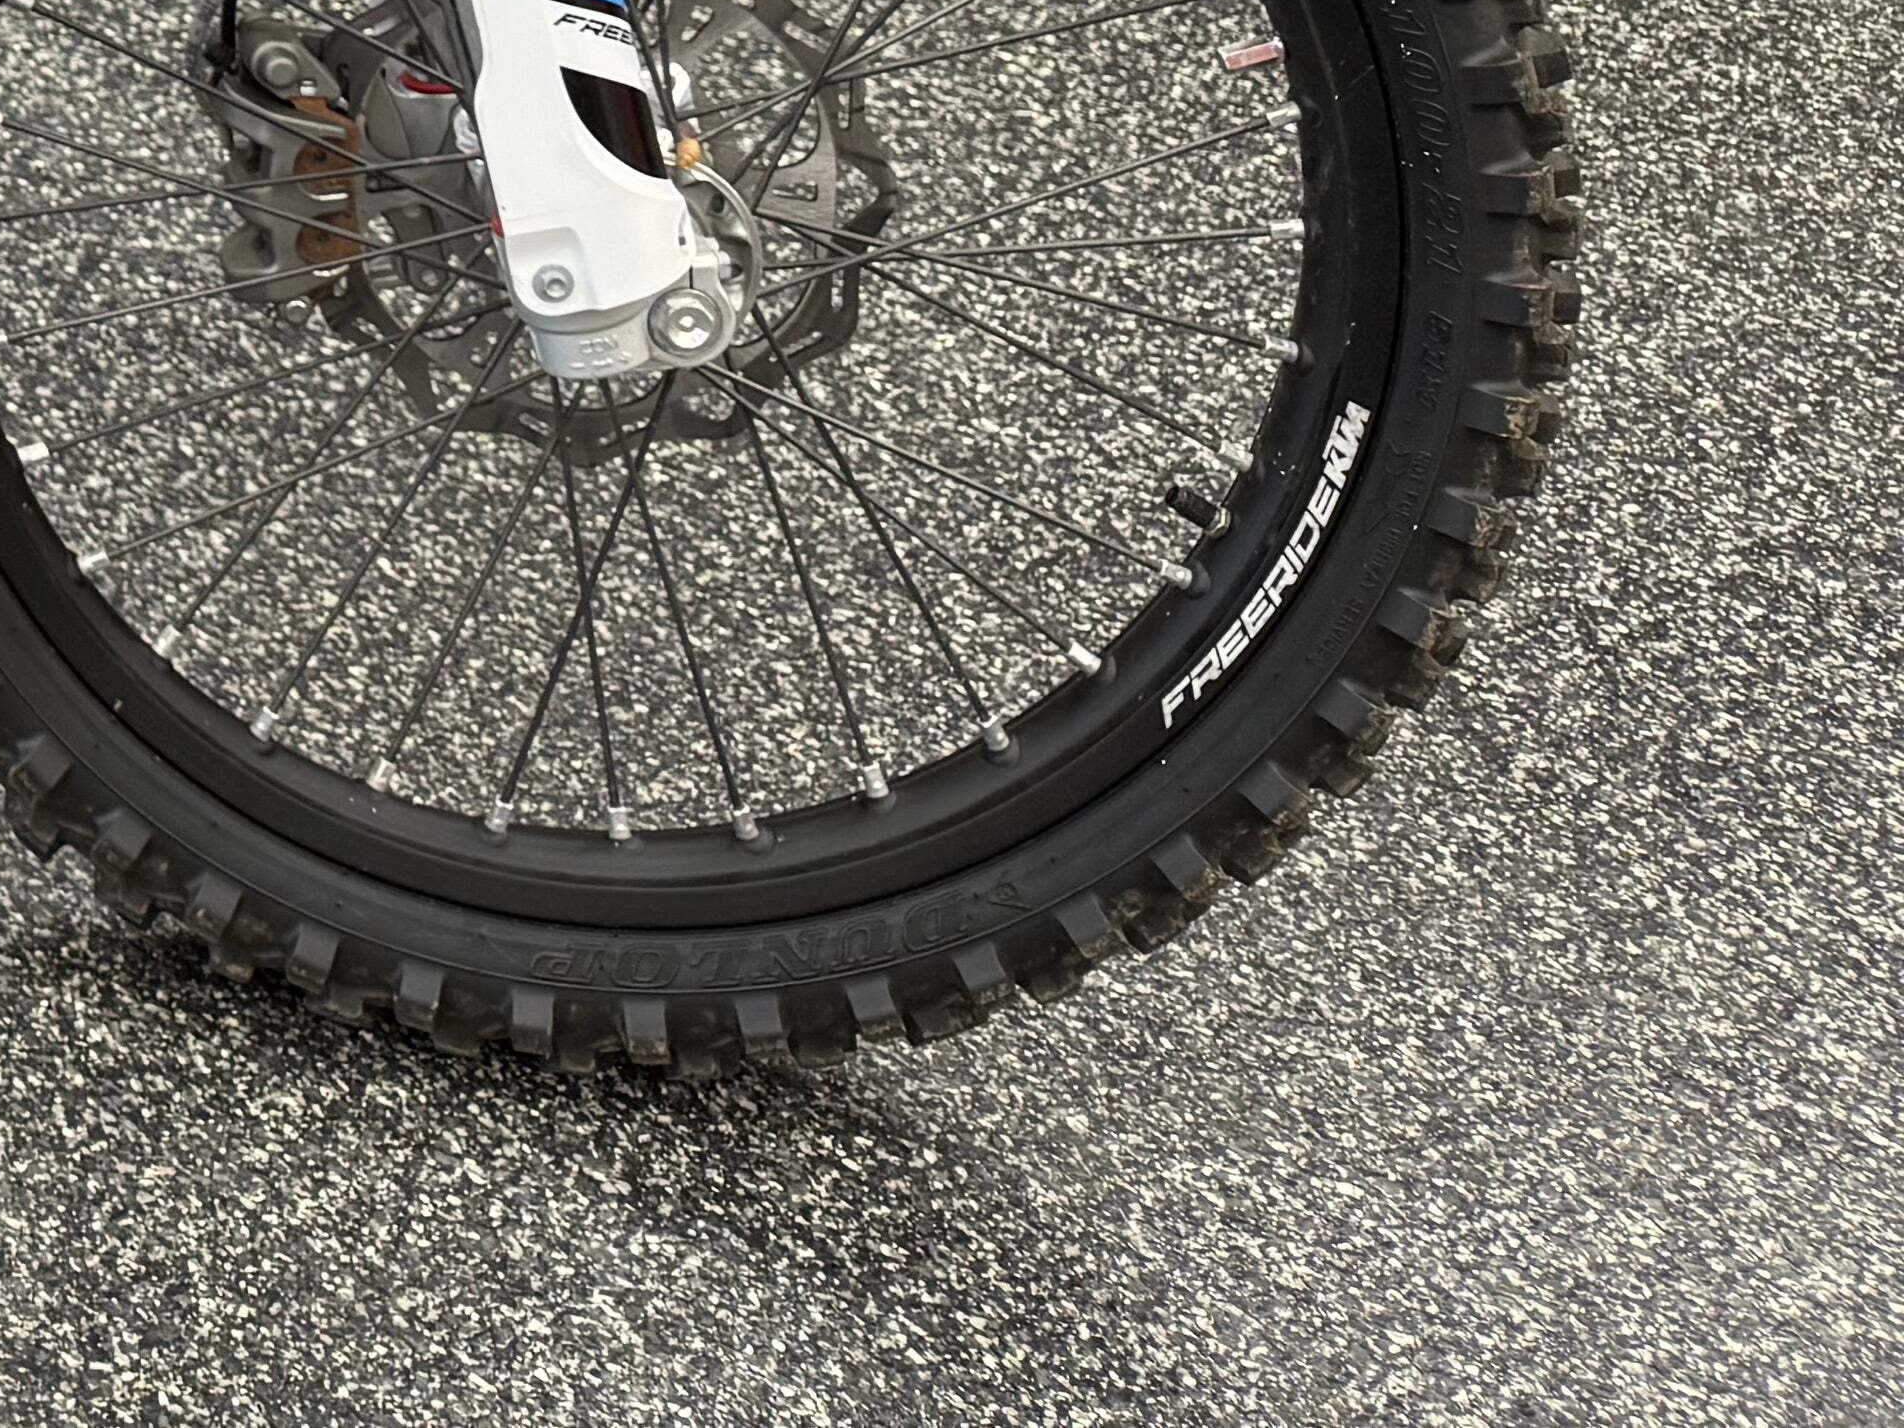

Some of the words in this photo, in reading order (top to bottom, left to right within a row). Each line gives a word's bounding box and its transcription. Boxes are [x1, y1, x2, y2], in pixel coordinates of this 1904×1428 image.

[1160, 484, 1343, 730] FREERIDE
[1322, 400, 1371, 492] KTM
[530, 886, 972, 988] DUNLOP
